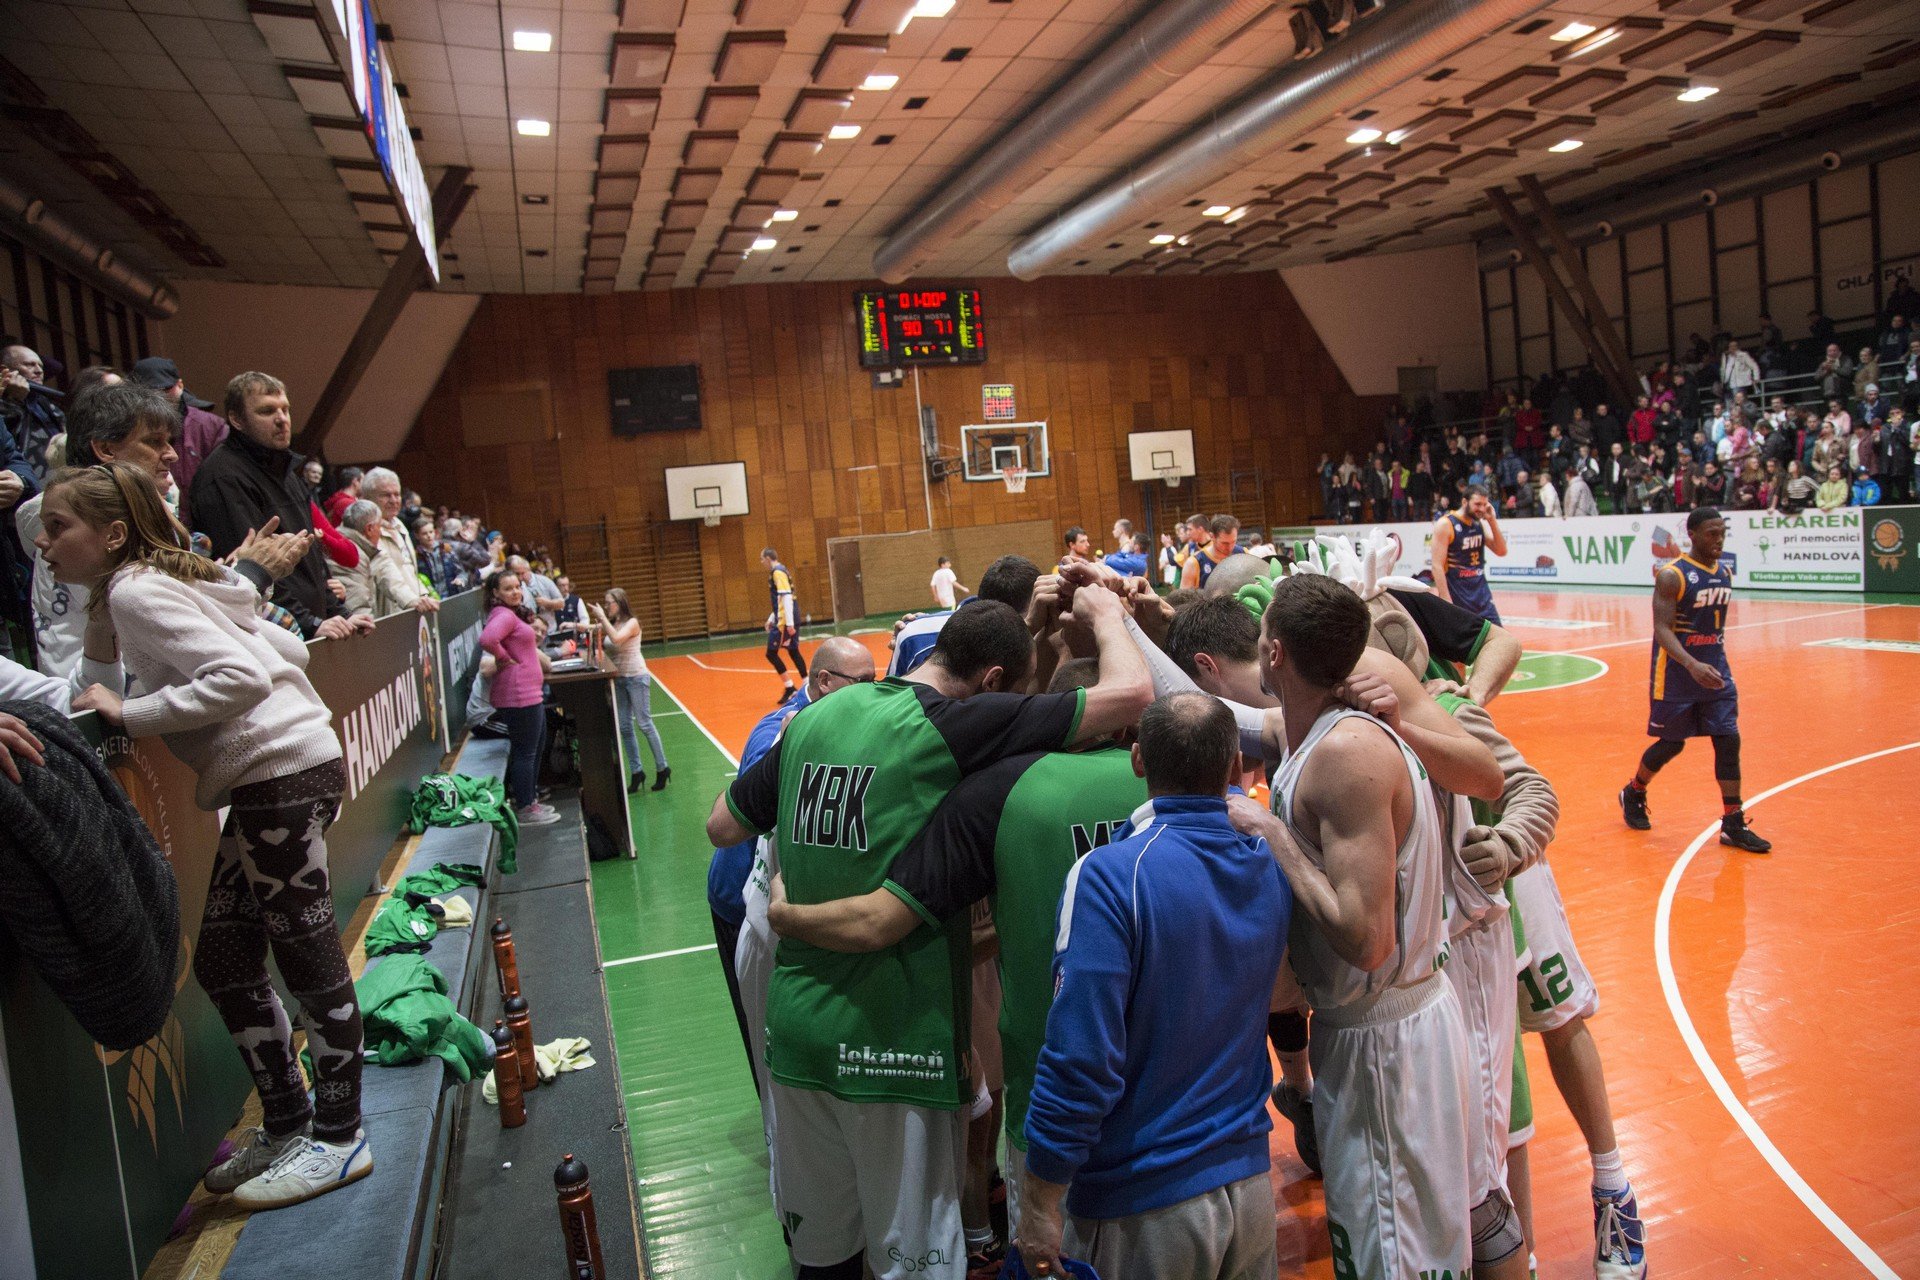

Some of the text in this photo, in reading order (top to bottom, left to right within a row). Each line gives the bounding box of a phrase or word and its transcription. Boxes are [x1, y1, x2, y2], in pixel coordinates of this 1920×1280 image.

[902, 320, 923, 336] 90
[933, 319, 953, 335] 71
[1462, 535, 1483, 550] SVIT
[1783, 533, 1860, 545] pri nemocnici
[1783, 550, 1860, 561] HANDLOVÁ
[1693, 587, 1732, 608] SVIT
[1714, 609, 1721, 630] 1
[343, 652, 422, 801] HANDLOVÁ
[792, 762, 876, 851] MBK
[155, 794, 172, 857] KLUB
[1517, 952, 1574, 1012] 12
[838, 1043, 944, 1069] lekáreň
[837, 1065, 944, 1081] pri nemocnici
